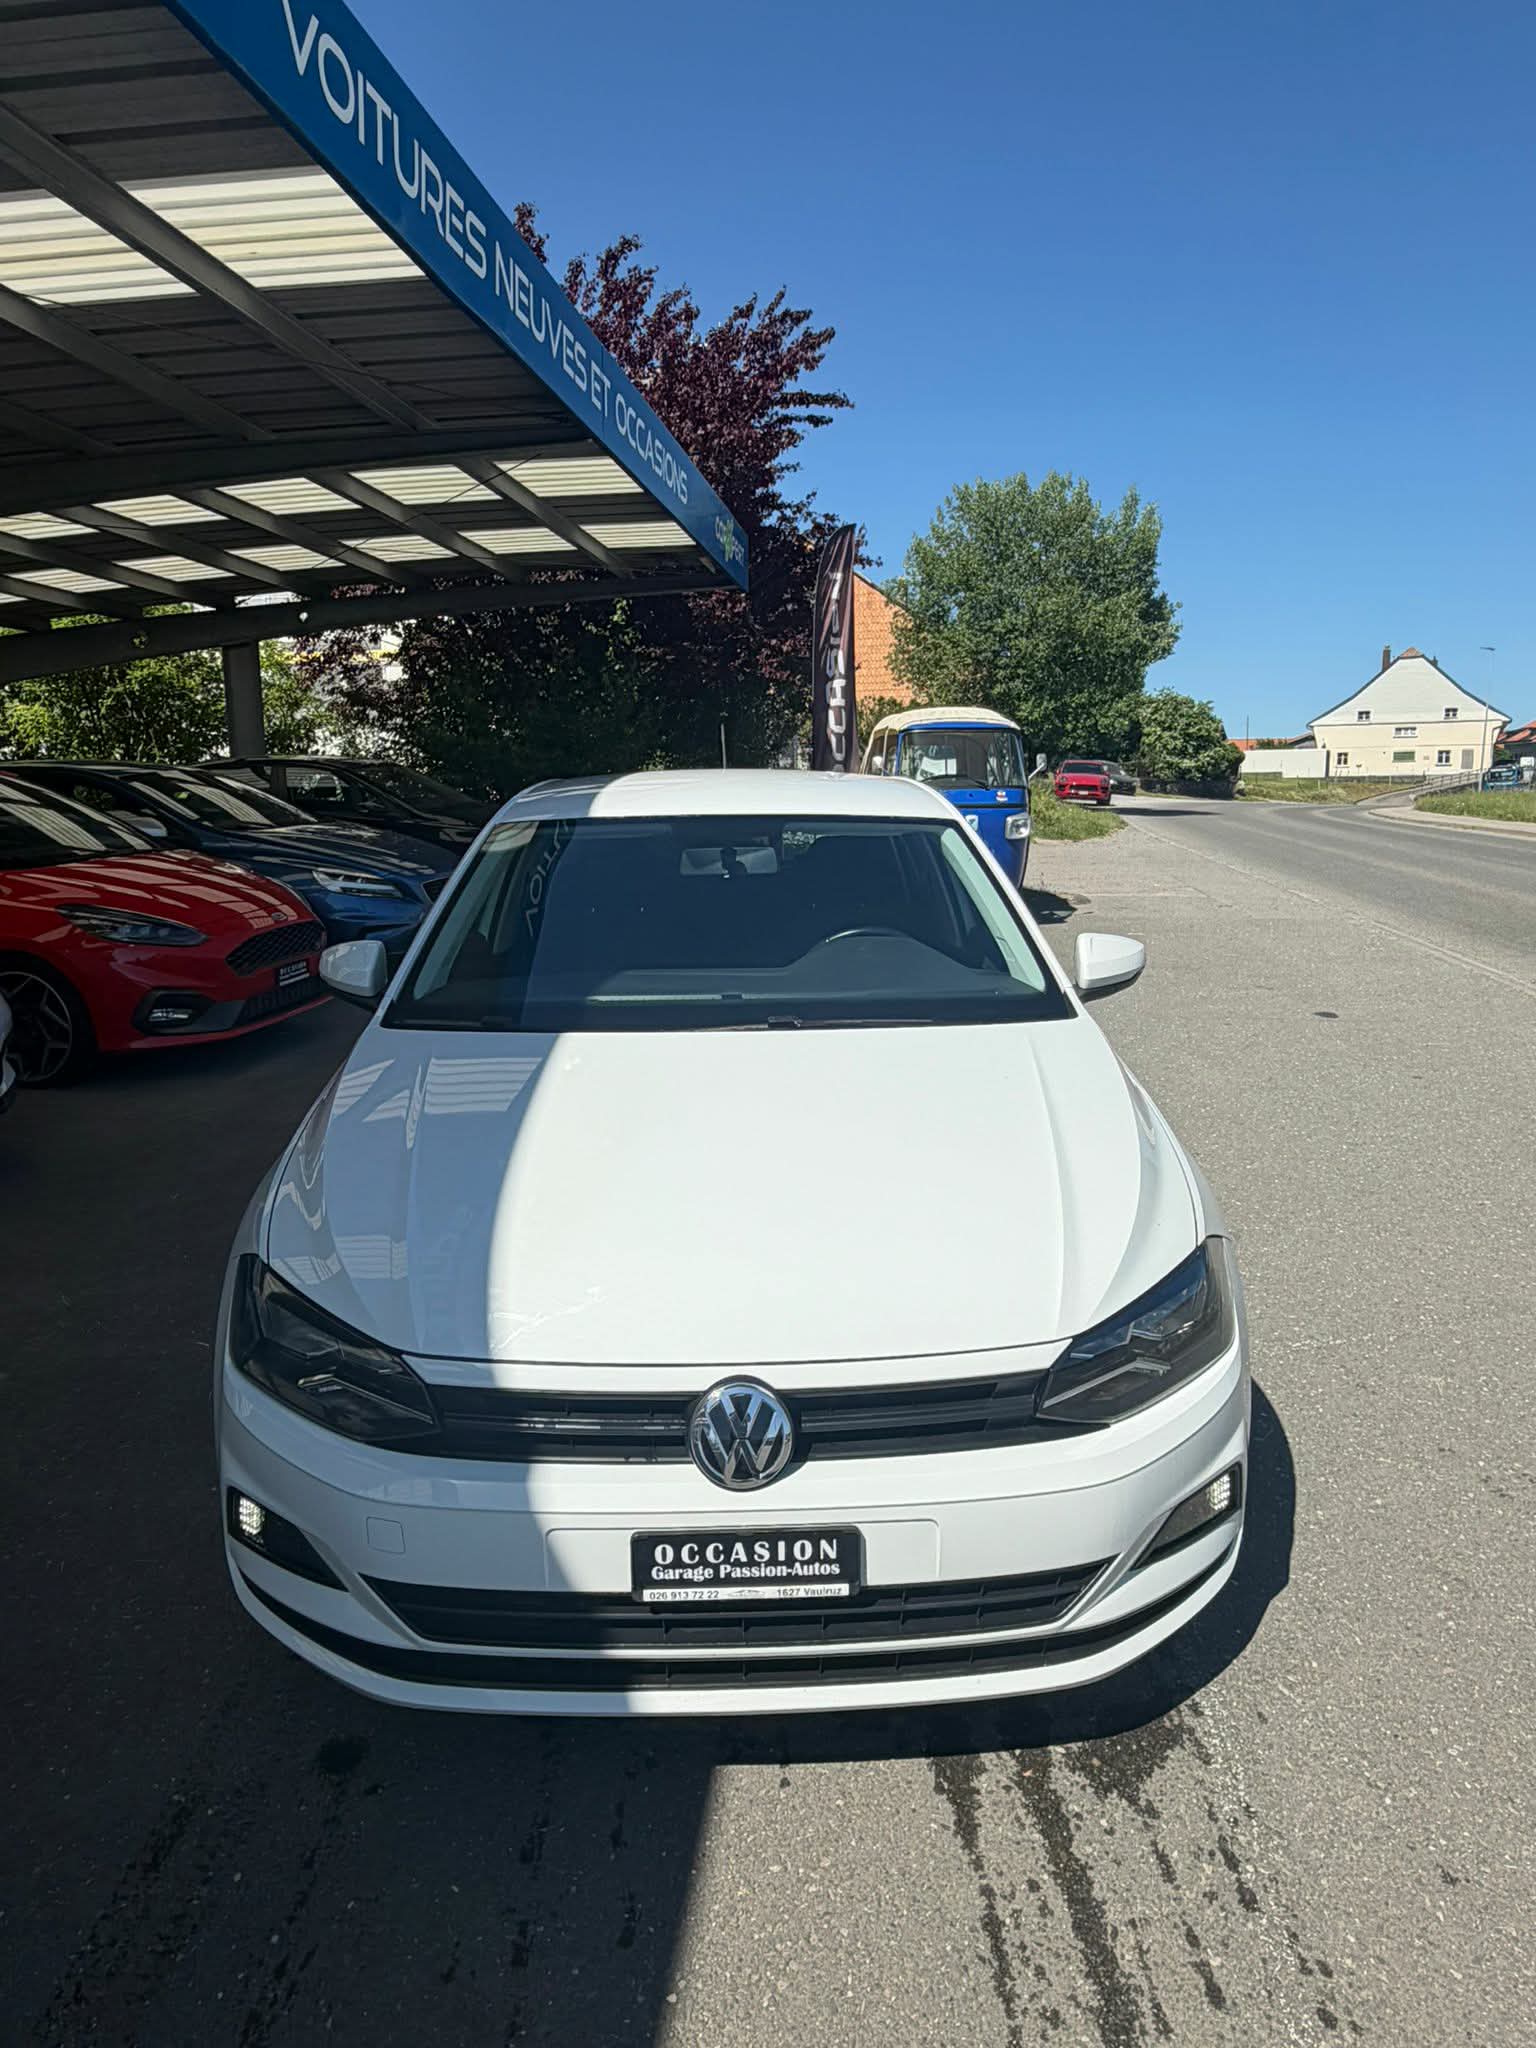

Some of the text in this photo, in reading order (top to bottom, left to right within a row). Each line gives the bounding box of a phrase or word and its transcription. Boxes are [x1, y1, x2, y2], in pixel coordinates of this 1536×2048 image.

[281, 0, 688, 505] VOITURES NEUVES ET OCCASIONS
[826, 571, 846, 771] CCASION
[654, 1539, 838, 1565] OCCASION
[651, 1562, 841, 1582] Garage Passion-Autos
[649, 1592, 668, 1600] 026
[670, 1591, 689, 1600] 913
[692, 1591, 703, 1599] 72
[707, 1590, 720, 1599] 22
[776, 1588, 801, 1597] 1627
